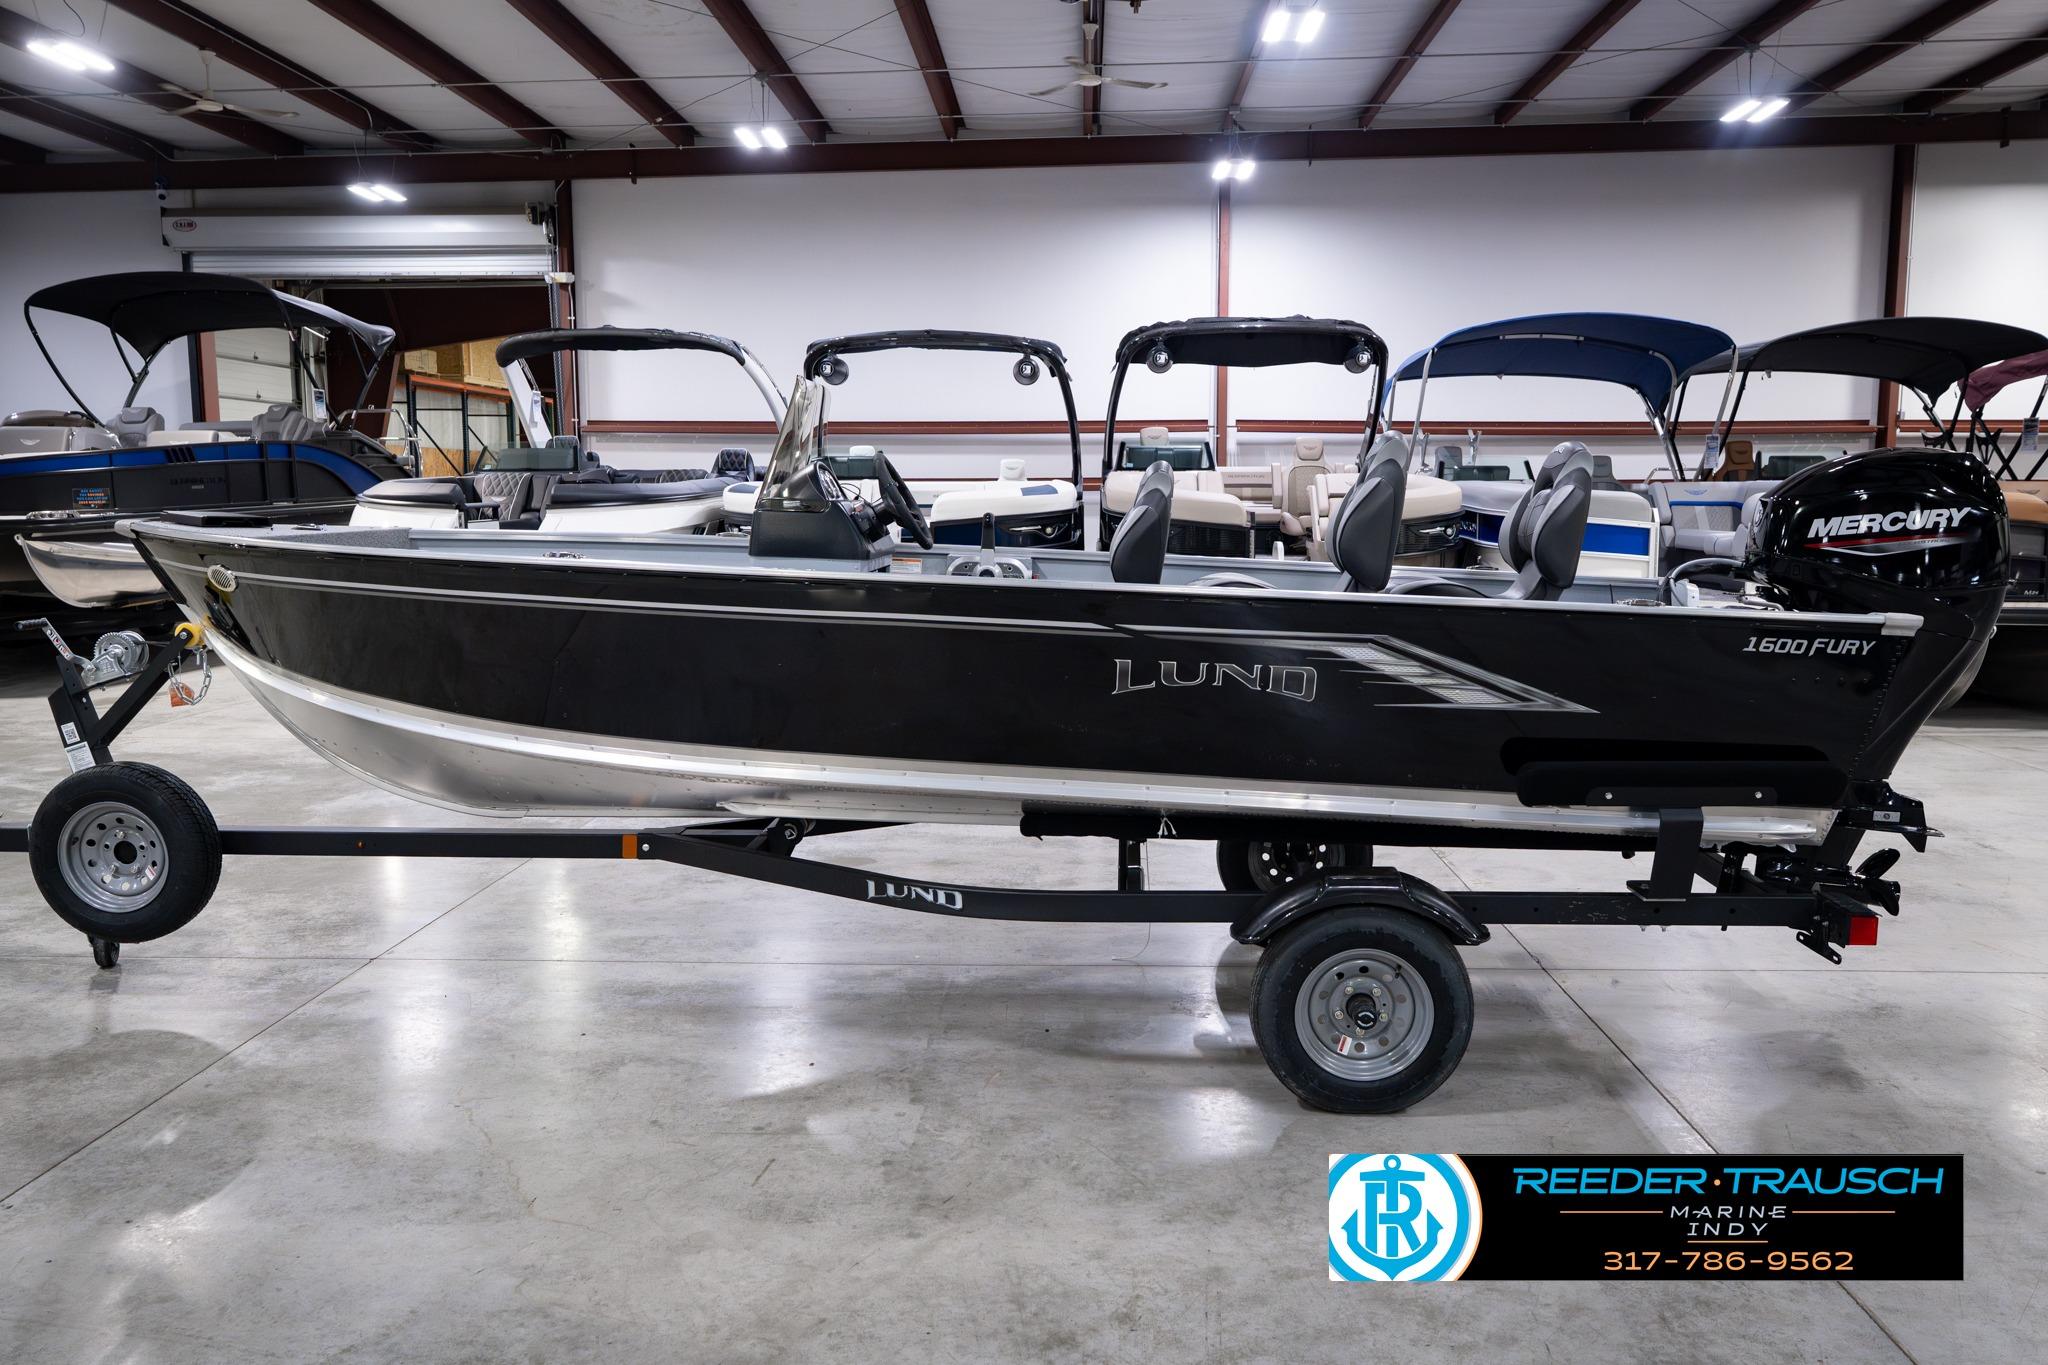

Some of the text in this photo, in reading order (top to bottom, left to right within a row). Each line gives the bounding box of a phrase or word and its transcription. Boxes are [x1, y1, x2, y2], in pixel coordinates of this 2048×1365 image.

[1807, 507, 1971, 538] MERCURY
[1742, 636, 1876, 657] 1600 FURY
[1112, 659, 1318, 702] LUND
[866, 879, 963, 910] LUND
